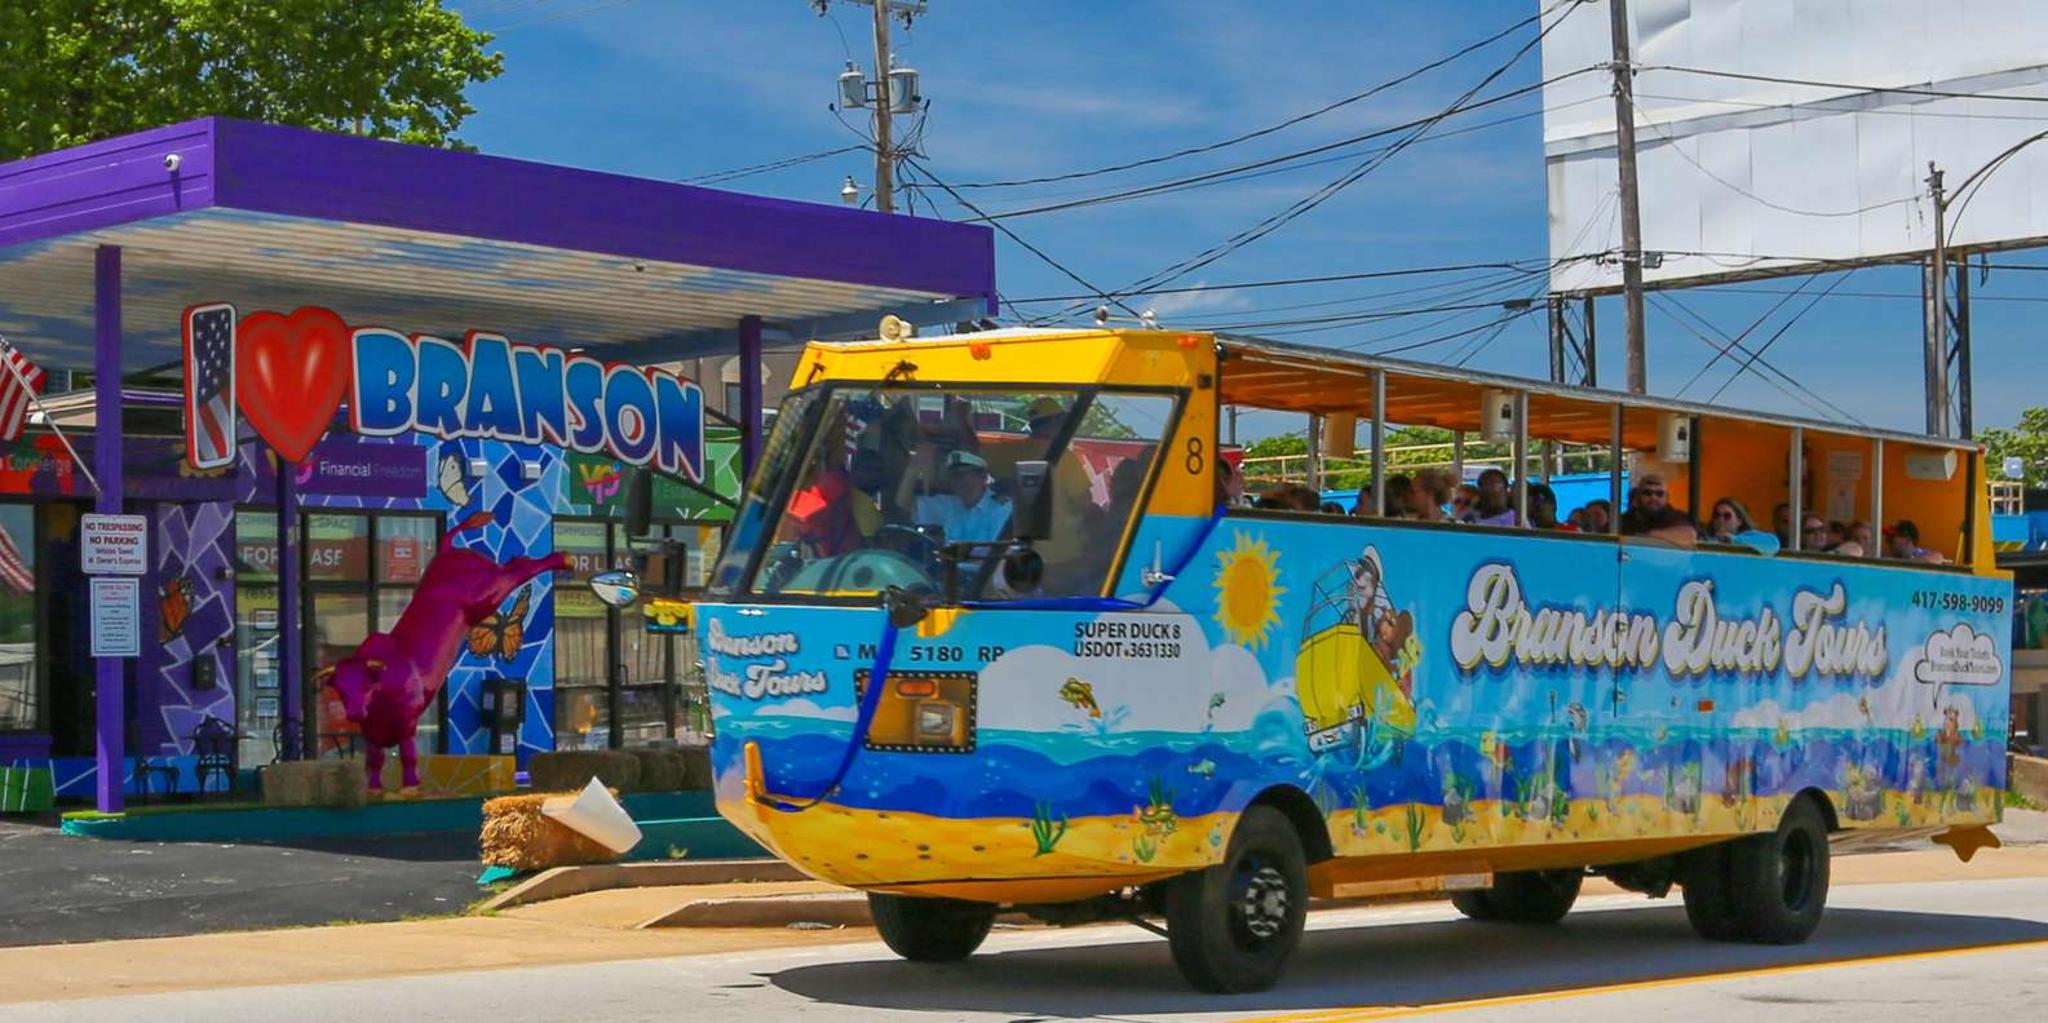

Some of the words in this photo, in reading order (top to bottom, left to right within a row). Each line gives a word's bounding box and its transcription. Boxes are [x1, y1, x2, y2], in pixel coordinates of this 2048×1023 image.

[350, 326, 706, 485] BRANSON
[1185, 436, 1203, 475] 8
[319, 460, 371, 477] Financial
[84, 522, 96, 531] NO
[98, 522, 144, 532] TRESPASSING
[89, 536, 102, 545] NO
[104, 536, 139, 545] PARKING
[1911, 591, 2005, 613] 417-598-9099
[1451, 562, 1659, 673] Branson
[1662, 579, 1782, 677] Duck
[1784, 582, 1888, 679] Tours
[1074, 622, 1128, 638] SUPER
[1130, 623, 1170, 639] DUCK
[1172, 624, 1181, 639] 8
[909, 646, 964, 662] 5180
[977, 646, 1005, 662] RP
[743, 658, 827, 699] Tours
